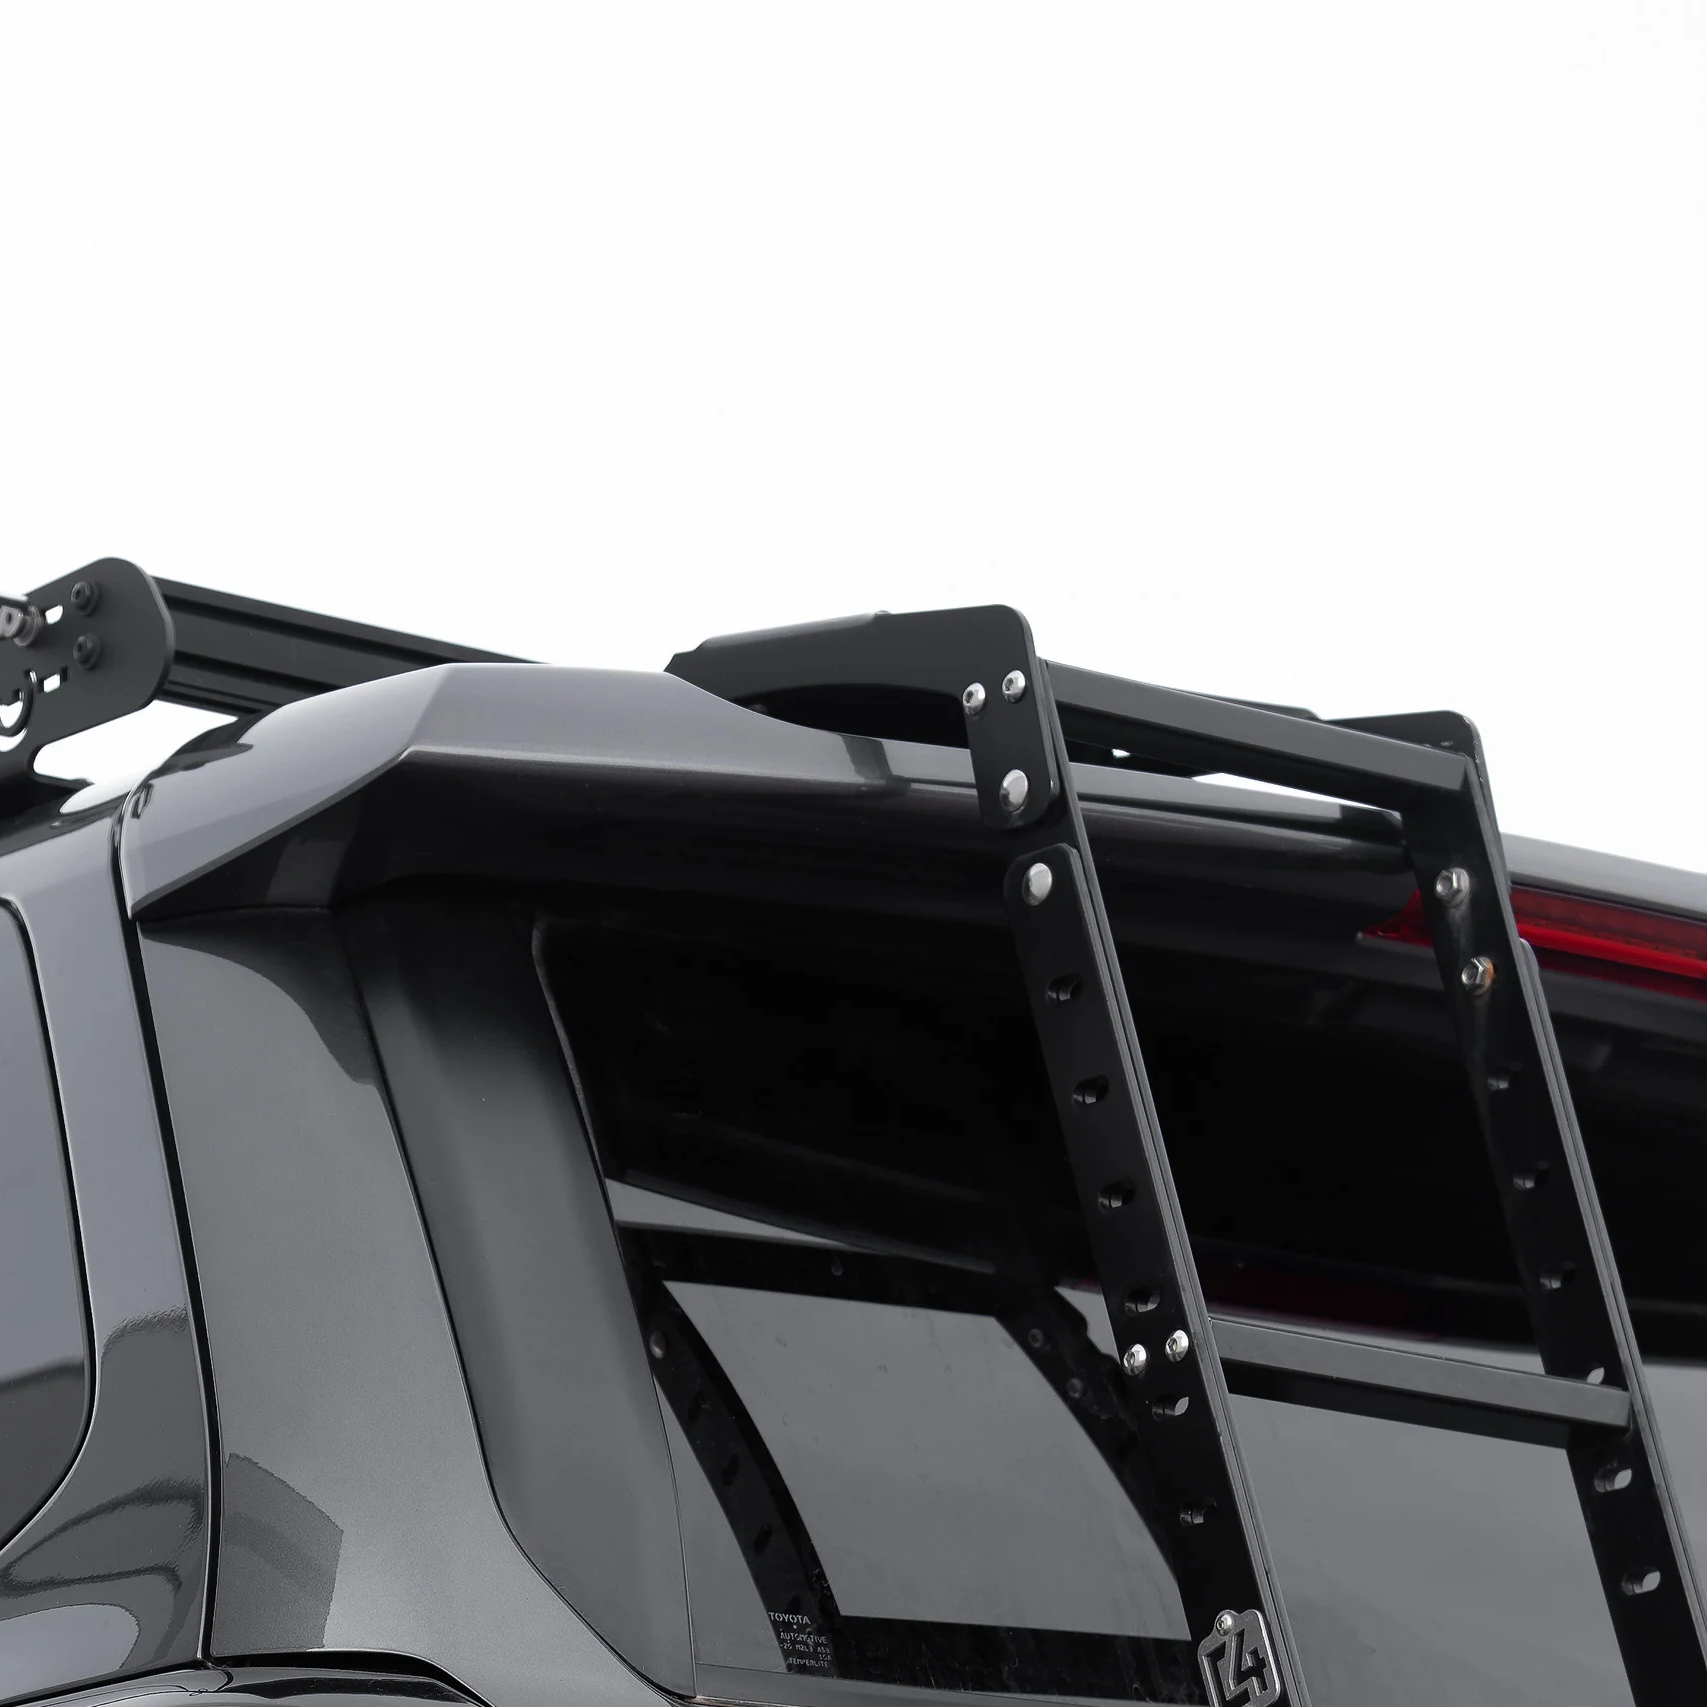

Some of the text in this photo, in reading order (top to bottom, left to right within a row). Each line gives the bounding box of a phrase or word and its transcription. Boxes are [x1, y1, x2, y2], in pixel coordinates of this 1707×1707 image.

[768, 1611, 812, 1625] TOYOTA
[780, 1632, 828, 1644] AUTOMOTIVE
[788, 1657, 829, 1668] TEMPERLITE
